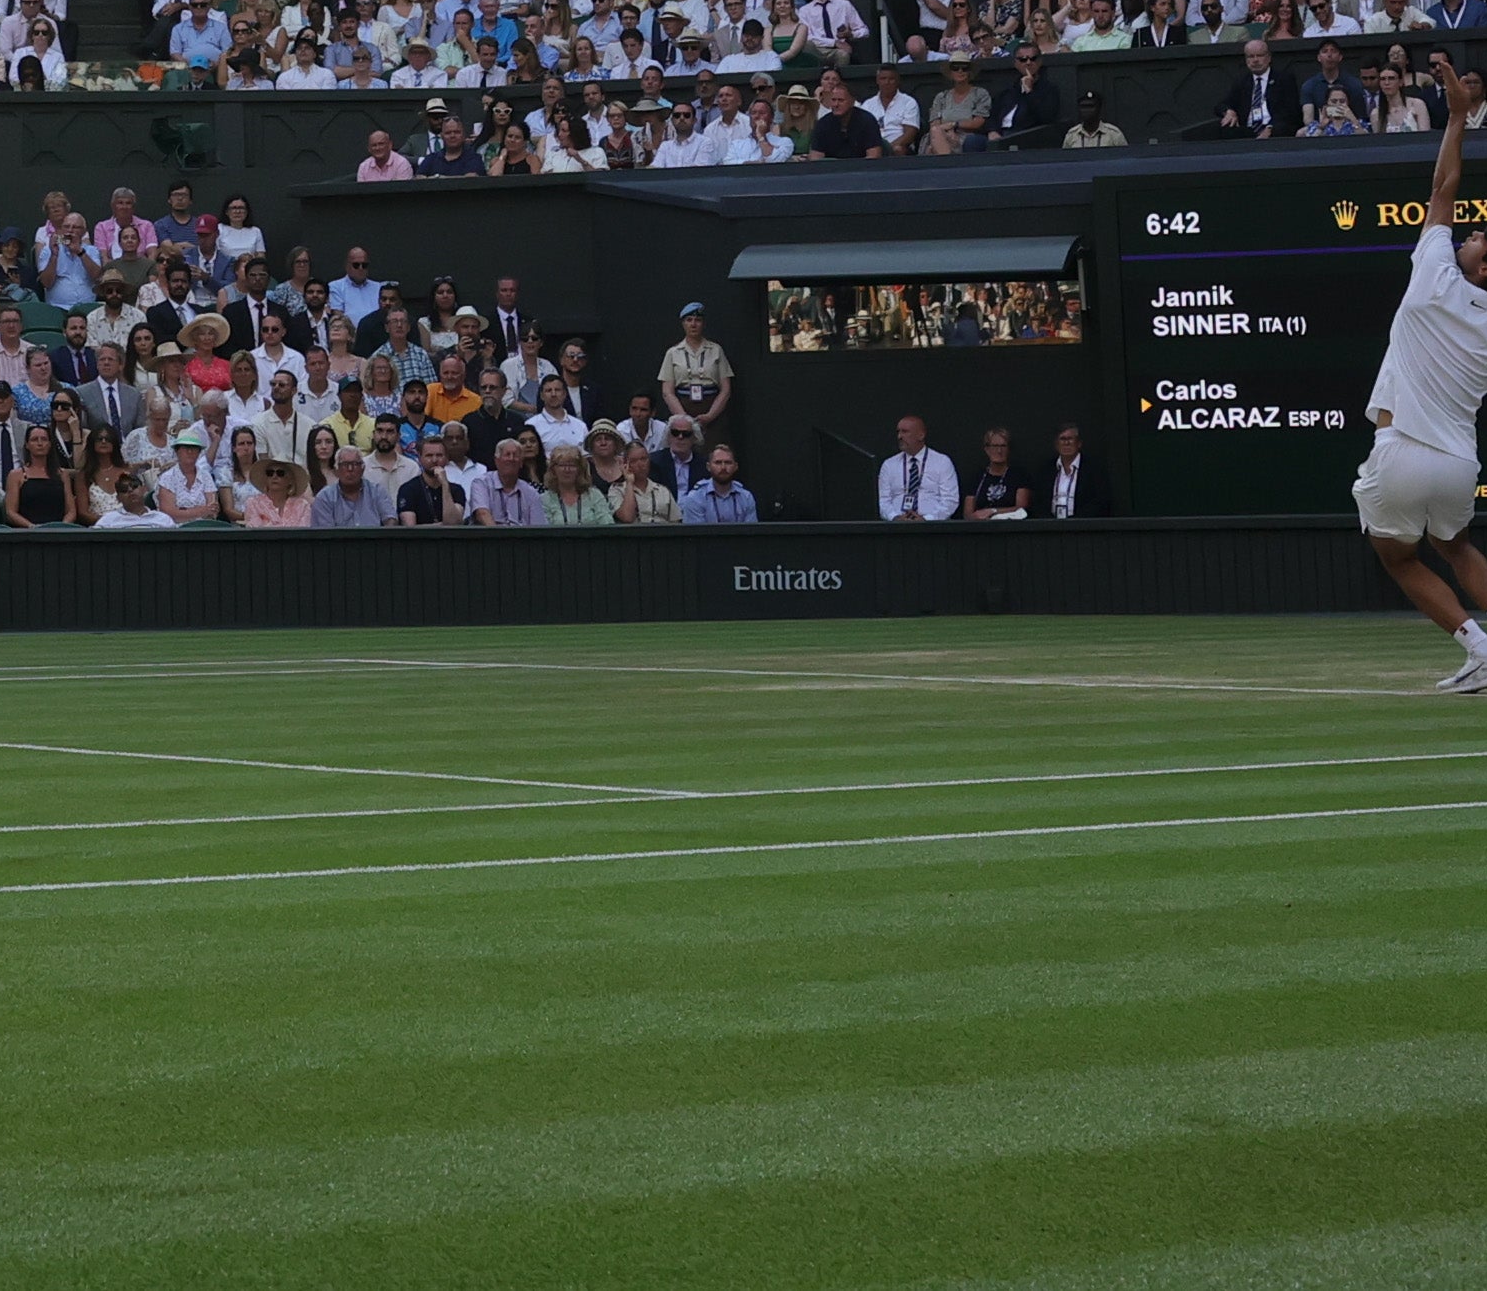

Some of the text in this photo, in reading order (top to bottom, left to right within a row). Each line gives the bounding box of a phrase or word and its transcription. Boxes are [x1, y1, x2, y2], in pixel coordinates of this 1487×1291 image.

[1145, 211, 1201, 235] 6:42
[1151, 285, 1234, 308] Jannik
[1152, 313, 1307, 336] SINNER ITA (1)
[1156, 379, 1238, 401] Carlos
[1157, 406, 1345, 430] ALCARAZ ESP (2)
[733, 565, 843, 591] Emirates
